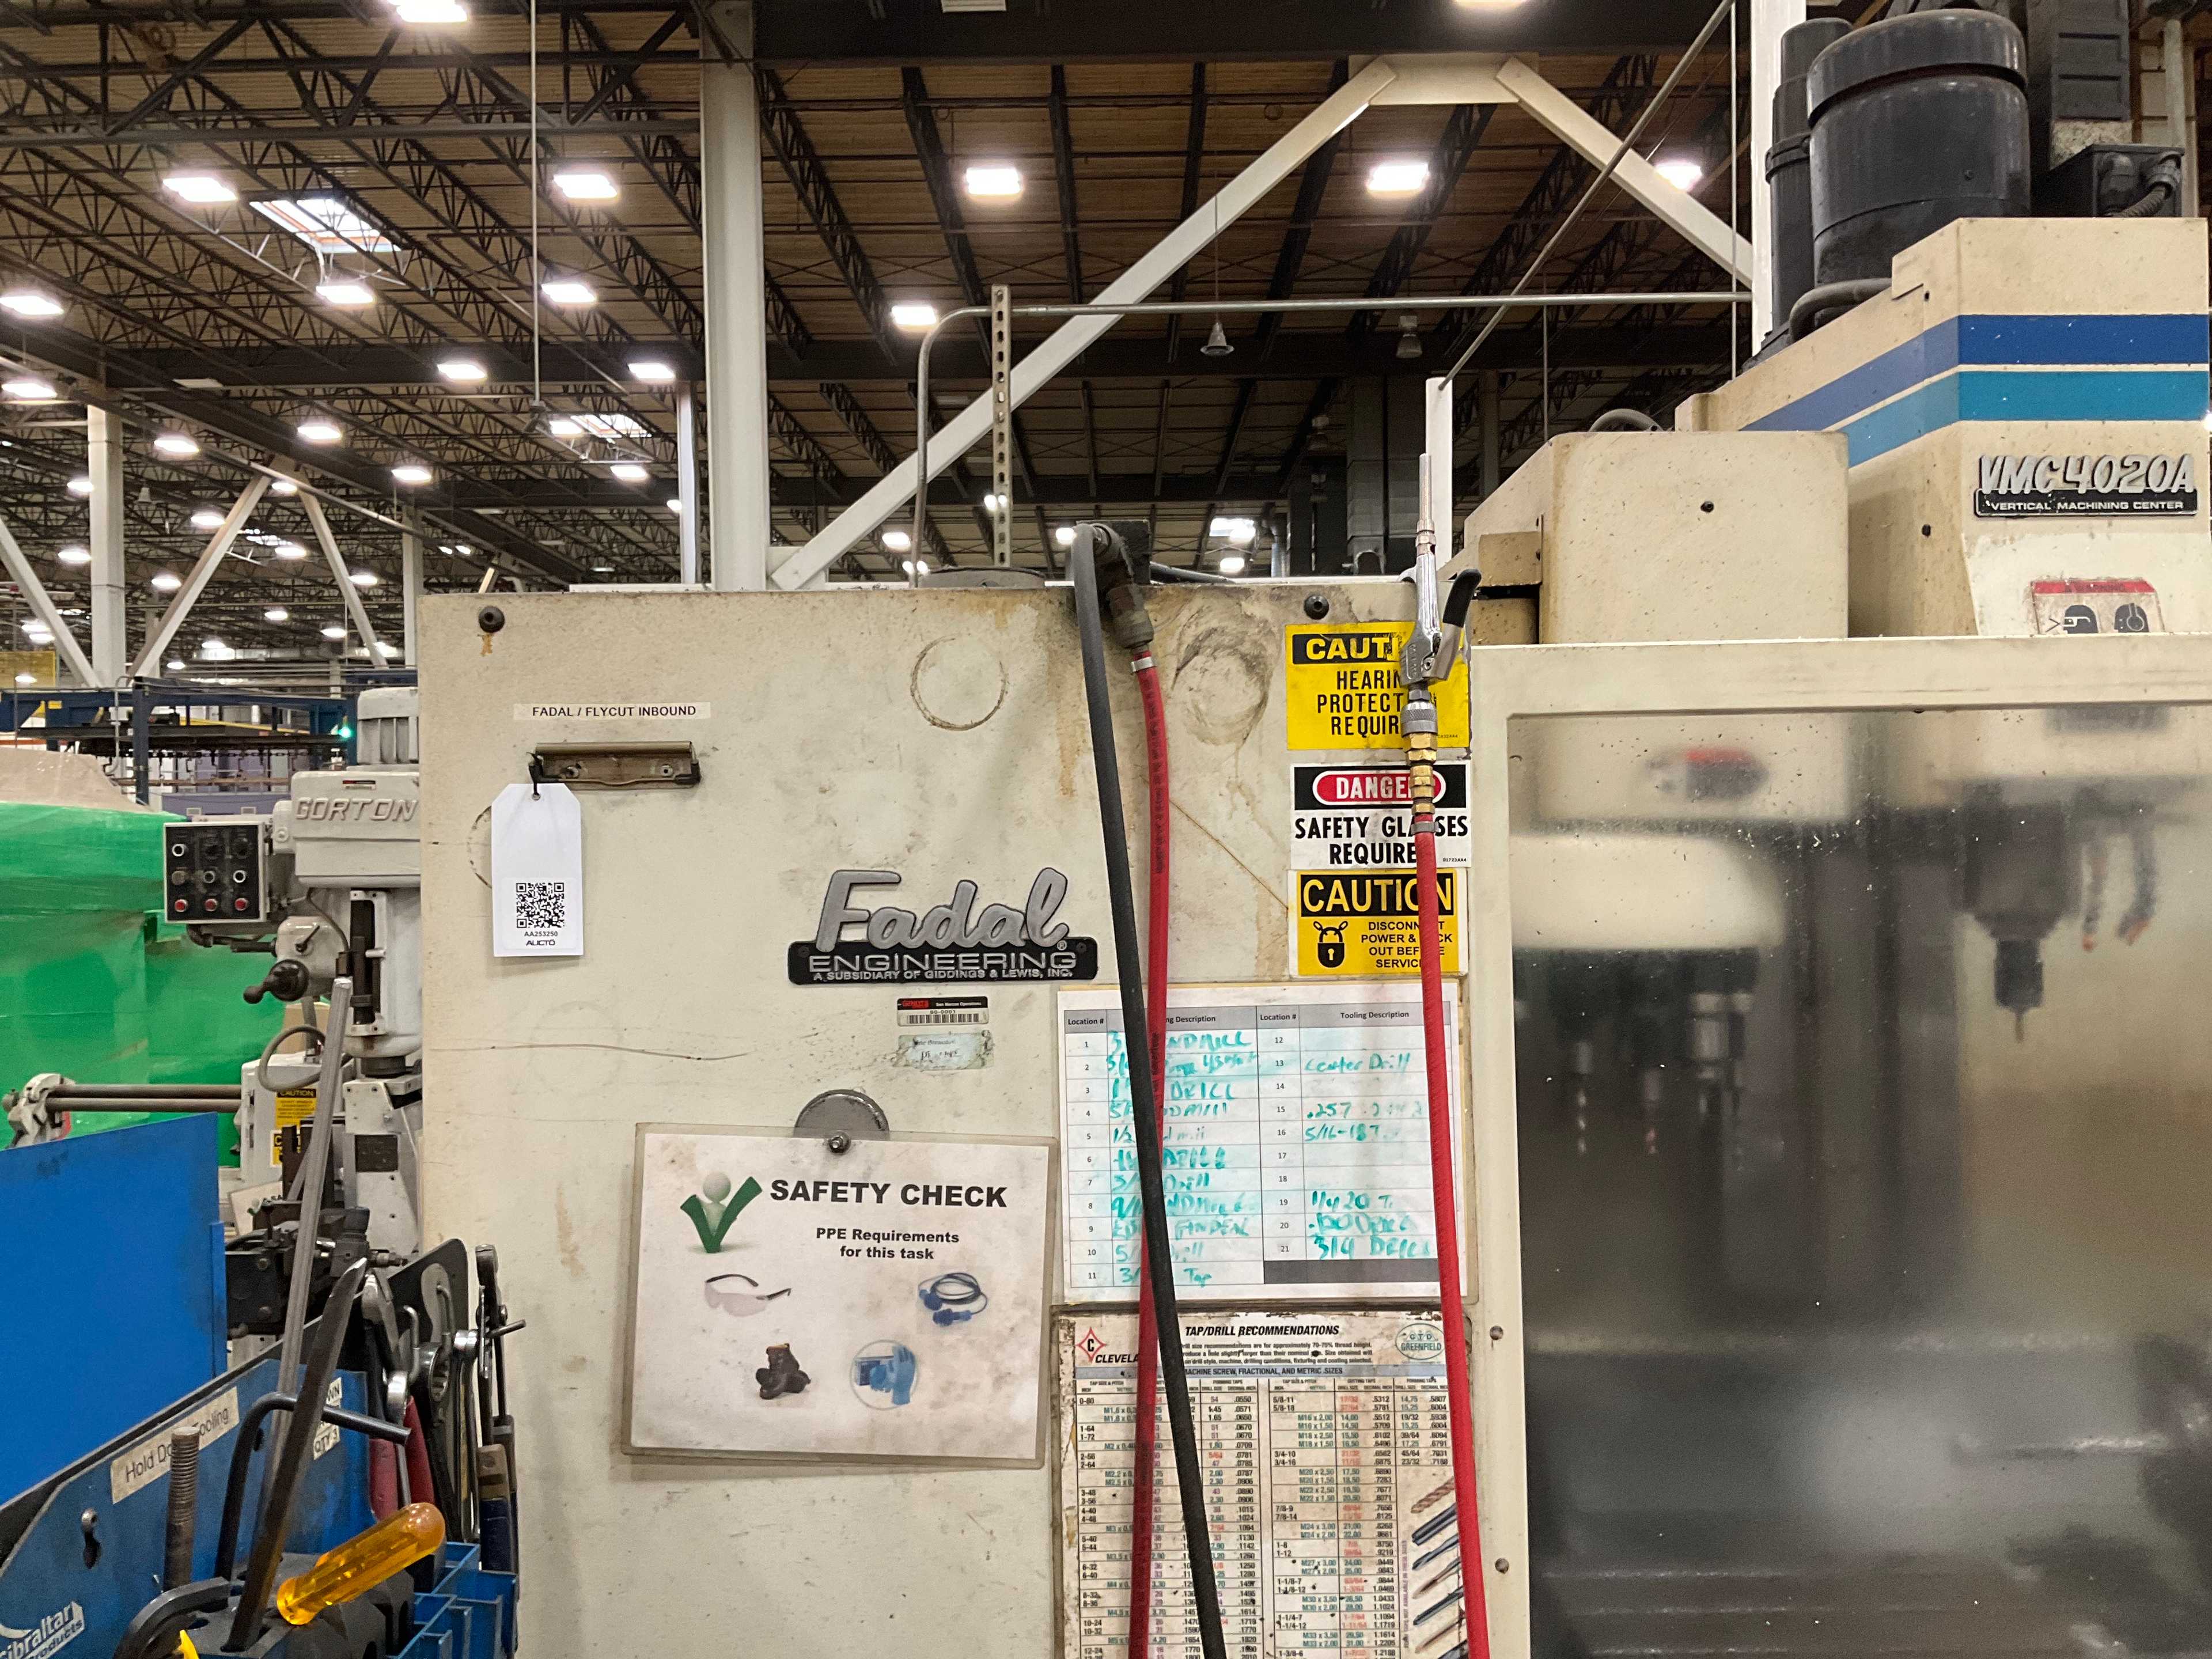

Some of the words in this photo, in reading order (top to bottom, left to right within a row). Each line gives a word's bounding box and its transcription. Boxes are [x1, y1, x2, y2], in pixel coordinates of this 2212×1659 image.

[1991, 502, 2051, 510] VERTICAL
[2057, 502, 2129, 510] MACHINING
[2133, 501, 2184, 510] CENTER
[1306, 638, 1402, 660] CAUTI
[1337, 670, 1402, 690] HEARIN
[1317, 692, 1404, 714] PROTECT
[532, 707, 574, 717] FADAL
[577, 707, 582, 717] /
[586, 706, 635, 717] FLYCUT
[639, 706, 696, 716] INBOUND
[1331, 715, 1399, 738] REQUIR
[1336, 777, 1410, 799] DANGE
[296, 797, 418, 822] GORTON
[1295, 817, 1369, 839] SAFETY
[1382, 816, 1468, 838] GLASES
[1330, 843, 1417, 865] REQUIRE
[816, 867, 1070, 953] Fadal
[1369, 921, 1445, 931] DISCONNT
[1361, 934, 1405, 943] POWER
[1408, 934, 1416, 943] &
[1369, 947, 1393, 956] OUT
[1397, 946, 1445, 956] BEFE
[809, 952, 1077, 972] ENGINEERING
[813, 972, 823, 980] A
[827, 971, 901, 980] SUBSIDIARY
[903, 970, 921, 979] OF
[924, 969, 986, 979] GIDDINGS
[989, 969, 998, 978] &
[1002, 969, 1044, 979] LEWIS,
[1176, 1016, 1216, 1024] Description
[1340, 1012, 1367, 1020] Tooling
[1369, 1011, 1410, 1020] Description
[770, 1179, 891, 1204] SAFETY
[900, 1184, 1007, 1208] CHECK
[816, 1228, 847, 1240] PPE
[852, 1228, 960, 1244] Requirements
[840, 1245, 862, 1258] for
[867, 1247, 895, 1259] this
[900, 1248, 934, 1260] task
[1185, 1326, 1236, 1336] TAP/DRILL
[1238, 1325, 1339, 1336] RECOMMENDATIONS
[1400, 1343, 1442, 1351] GREENFIELD
[1095, 1354, 1138, 1363] CLEVELA
[1213, 1368, 1238, 1376] SCREW,
[1238, 1368, 1281, 1376] FRACTIONAL,
[125, 1455, 154, 1483] Hold
[0, 1602, 74, 1659] ibraltar
